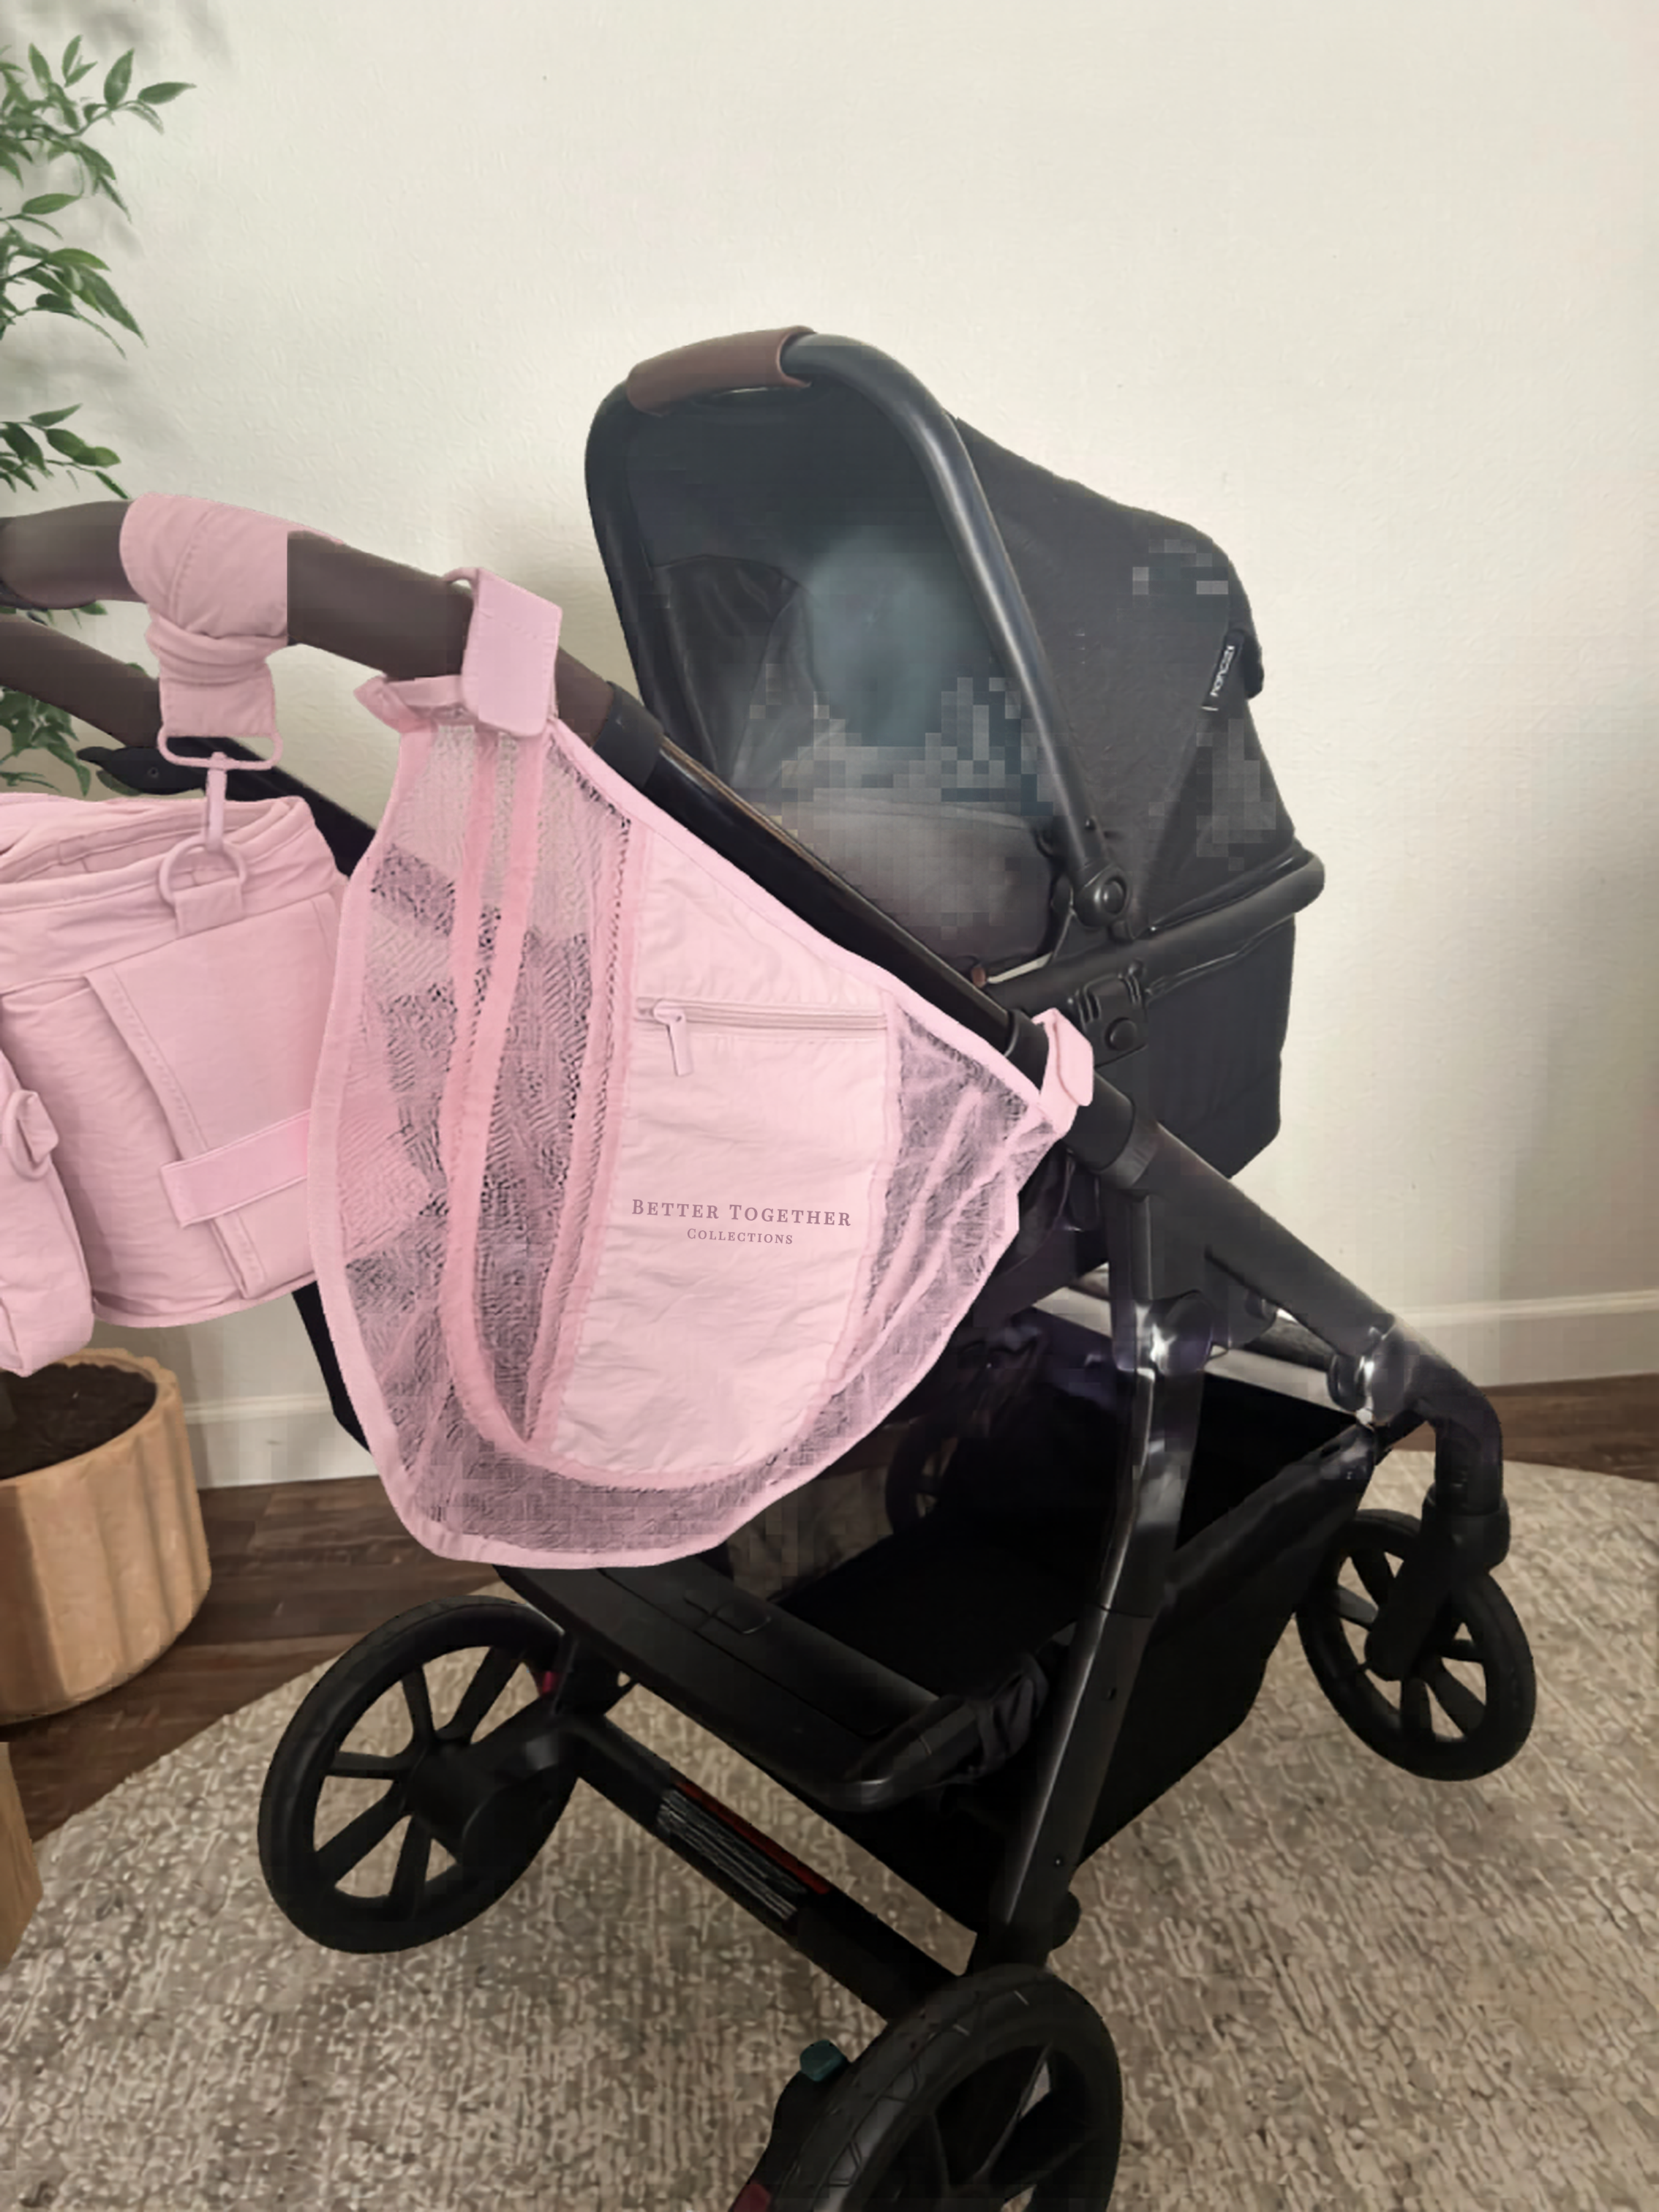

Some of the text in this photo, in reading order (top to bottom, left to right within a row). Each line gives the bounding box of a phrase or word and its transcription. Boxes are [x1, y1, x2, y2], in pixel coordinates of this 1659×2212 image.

[631, 1199, 851, 1226] BETTER TOGETHER
[687, 1228, 793, 1244] COLLECTIONS
